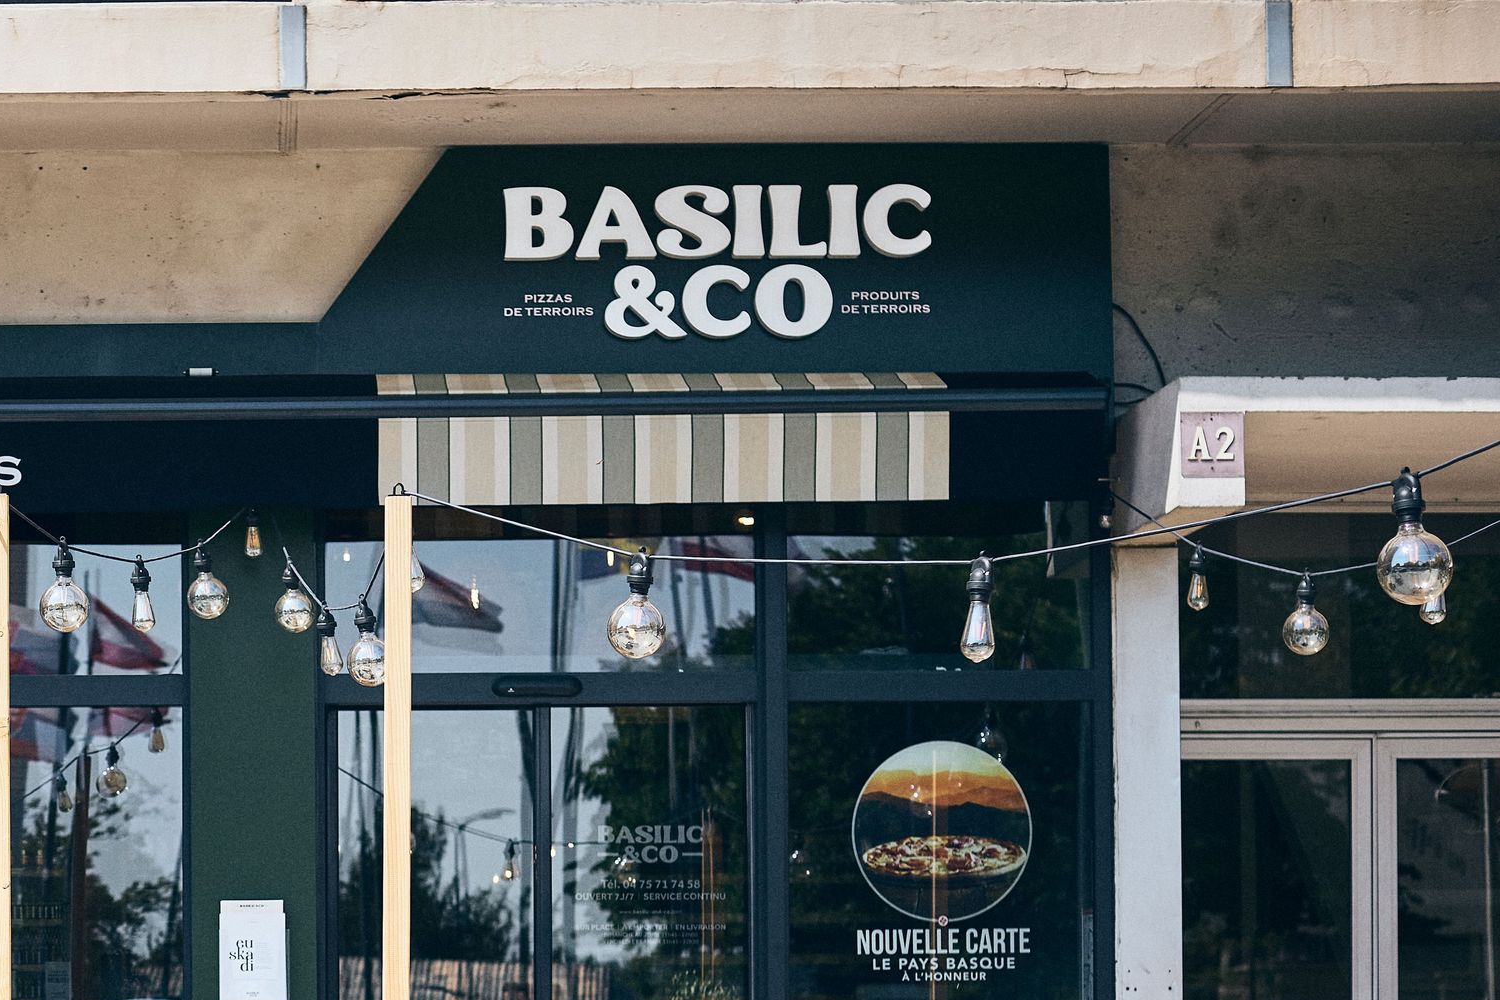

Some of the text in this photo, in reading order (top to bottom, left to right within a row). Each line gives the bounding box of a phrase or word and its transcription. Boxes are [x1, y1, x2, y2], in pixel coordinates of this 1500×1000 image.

[503, 184, 932, 261] BASILIC
[524, 293, 573, 304] PIZZAS
[604, 264, 834, 339] &CO
[851, 290, 920, 301] PRODUITS
[503, 306, 594, 317] DE TERROIRS
[841, 303, 931, 315] DE TERROIRS
[1187, 425, 1236, 462] A2
[597, 825, 703, 844] BASILIC
[622, 845, 679, 864] &CO
[639, 879, 653, 889] 75
[655, 879, 668, 889] 71
[671, 879, 685, 889] 74
[687, 879, 701, 889] 58
[575, 892, 612, 901] OUVERT
[643, 892, 682, 901] SERVICE
[683, 892, 726, 901] CONTINU
[856, 928, 1031, 955] NOUVELLE CARTE
[872, 957, 1016, 971] LE PAYS BASQUE
[901, 971, 910, 982] À
